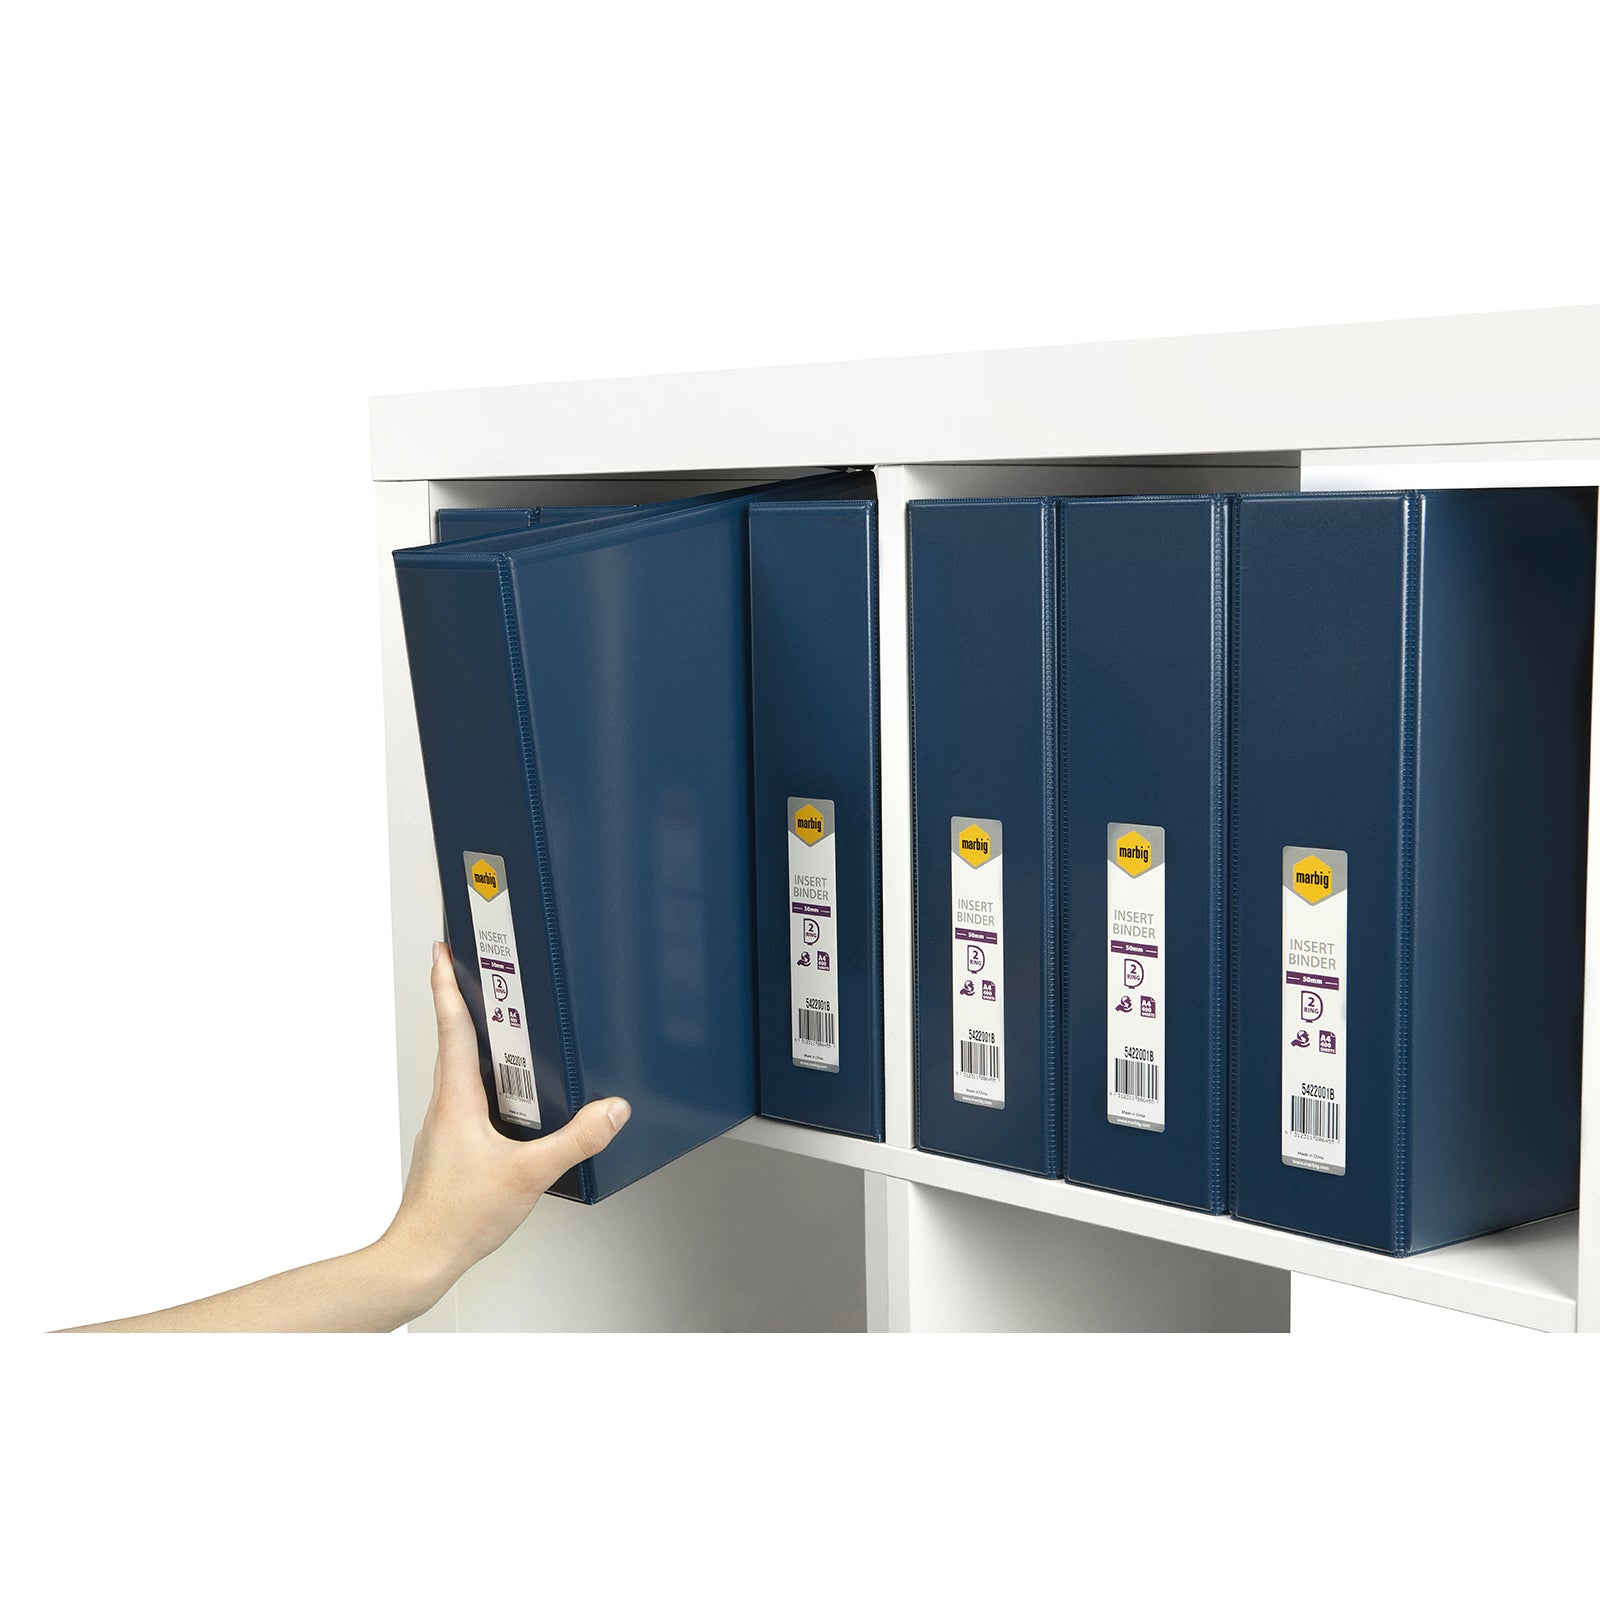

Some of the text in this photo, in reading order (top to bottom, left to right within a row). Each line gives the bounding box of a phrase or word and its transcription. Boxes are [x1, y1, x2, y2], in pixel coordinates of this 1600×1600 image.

[798, 817, 821, 832] marbig
[962, 838, 988, 854] marbig
[1120, 846, 1148, 862] marbig
[474, 872, 496, 888] marbig
[794, 875, 827, 888] INSERT
[1296, 871, 1328, 889] marbig
[794, 887, 829, 900] BINDER
[958, 898, 993, 912] INSERT
[957, 912, 995, 926] BINDER
[1114, 910, 1154, 924] INSERT
[808, 924, 814, 932] 2
[1113, 924, 1156, 939] BINDER
[479, 930, 507, 944] INSERT
[480, 942, 511, 957] BINDER
[1126, 944, 1143, 952] 50mm
[1290, 938, 1335, 954] INSERT
[973, 950, 978, 960] 2
[1288, 953, 1336, 970] BINDER
[1130, 964, 1136, 974] 2
[497, 980, 502, 988] 2
[1302, 976, 1322, 984] 50mm
[806, 998, 830, 1011] 5422001B
[1308, 997, 1315, 1007] 2
[968, 1029, 995, 1043] 5422001B
[1124, 1046, 1154, 1062] 5422001B
[1302, 1083, 1334, 1100] 5422001B
